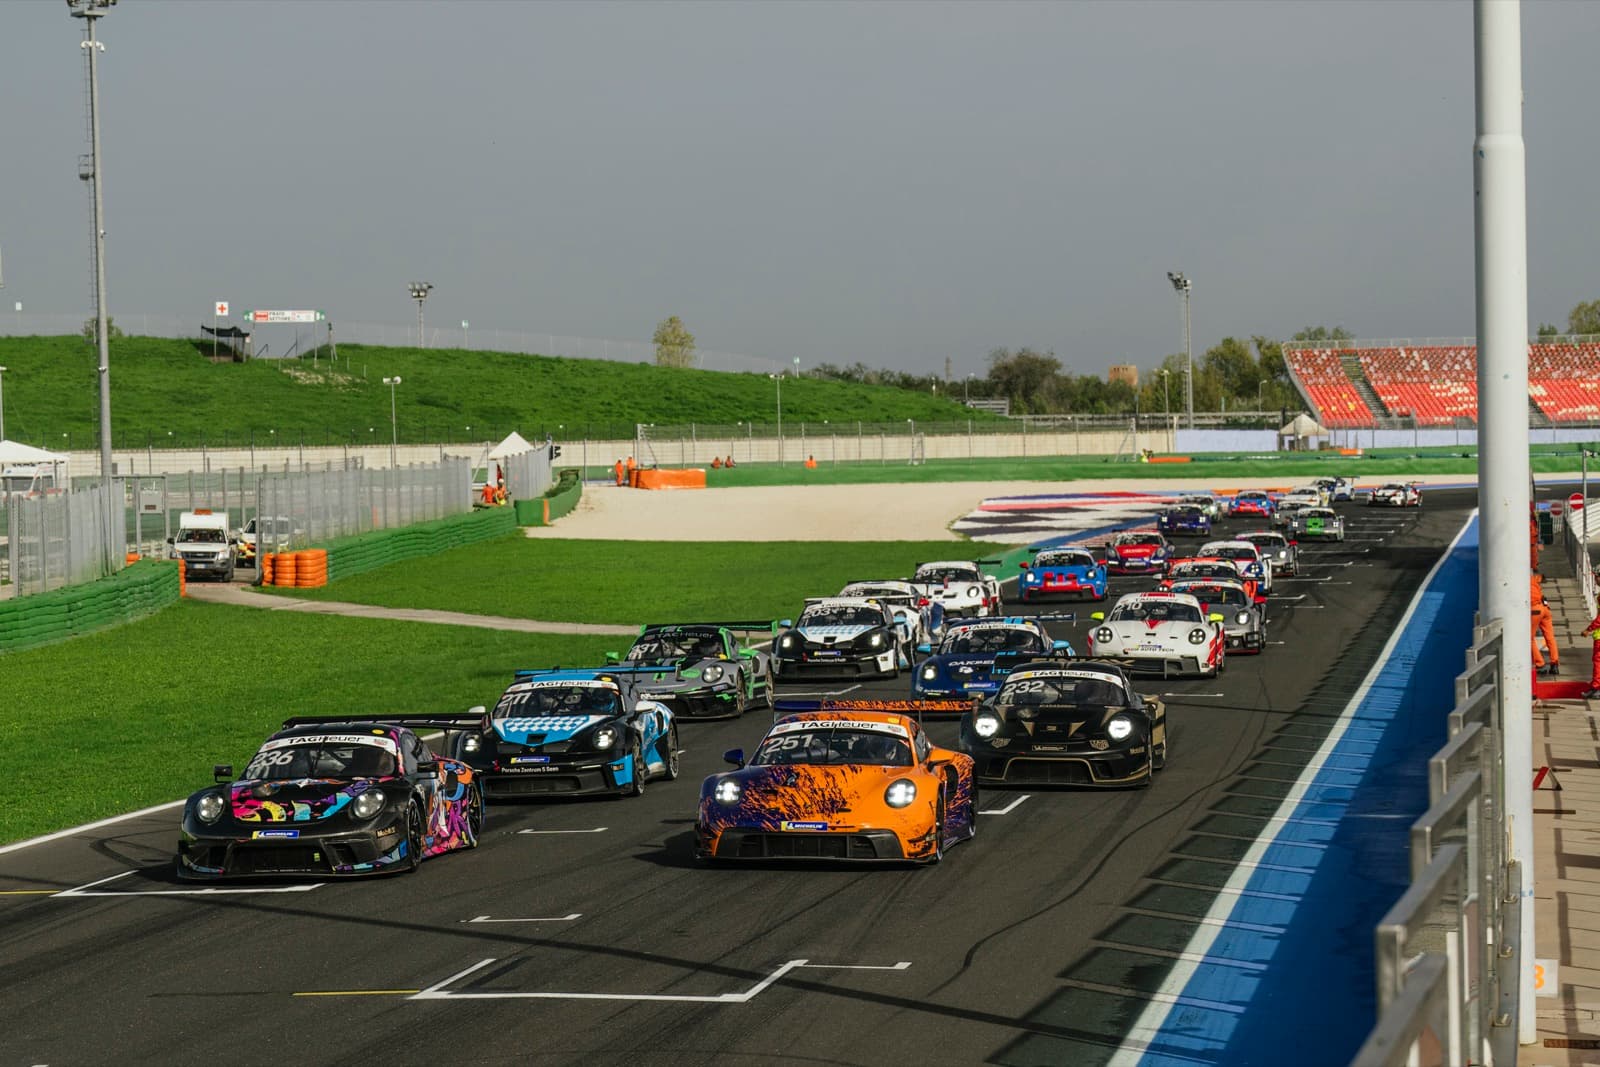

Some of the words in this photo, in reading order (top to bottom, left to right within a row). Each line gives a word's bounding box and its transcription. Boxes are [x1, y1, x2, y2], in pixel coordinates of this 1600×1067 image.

[1003, 681, 1045, 694] 232
[765, 734, 814, 753] 251
[250, 750, 295, 769] 236
